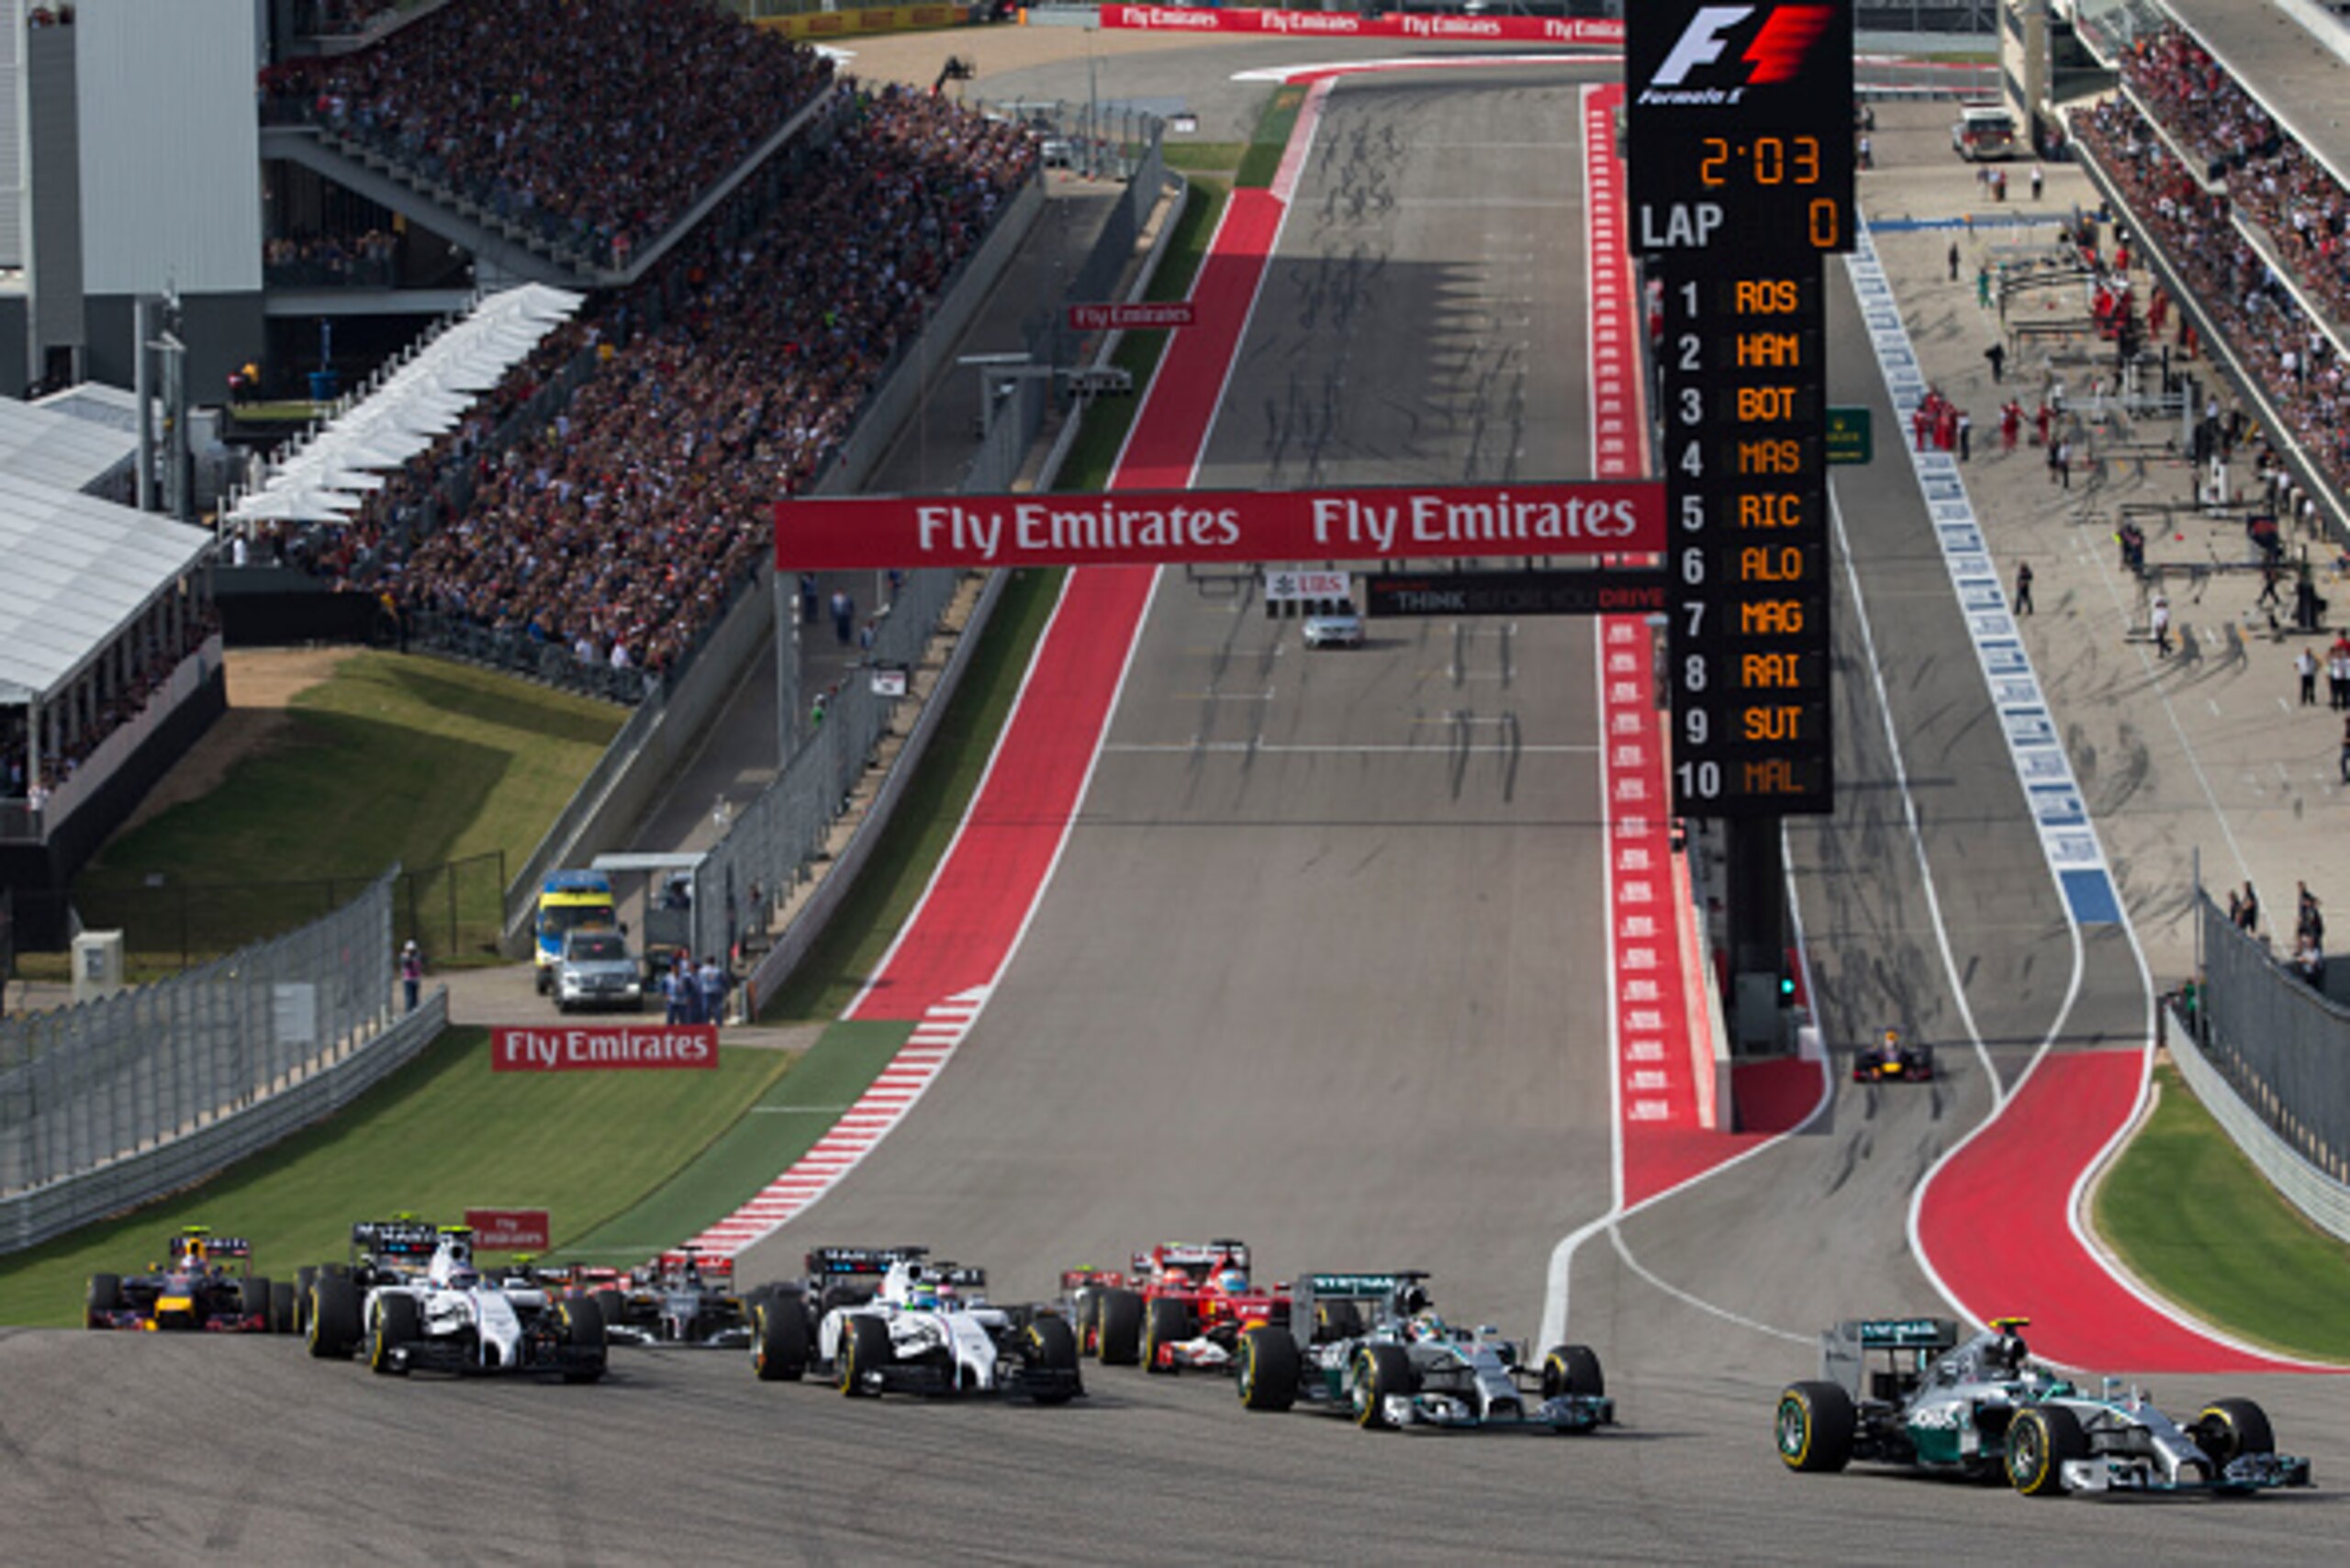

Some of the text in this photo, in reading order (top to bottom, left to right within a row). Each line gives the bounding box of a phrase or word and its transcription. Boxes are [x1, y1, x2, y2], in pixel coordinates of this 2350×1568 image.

[1122, 7, 1217, 28] Fly Emirates
[1260, 10, 1359, 33] Fly Emirates
[1403, 16, 1501, 37] Fly Emirates
[1545, 19, 1573, 40] Fly
[1637, 87, 1725, 105] Formula
[1701, 137, 1819, 185] 2:03
[1641, 198, 1837, 247] LAP 0
[1681, 279, 1798, 317] 1 ROS
[1076, 308, 1192, 326] Fly Emirates
[1679, 332, 1799, 370] 2 HAM
[1681, 386, 1796, 424] 3 BOT
[1681, 440, 1800, 476] 4 MAS
[1313, 492, 1636, 551] Fly Emirates
[1683, 493, 1801, 530] 5 RIC
[917, 502, 1240, 559] Fly Emirates
[1298, 575, 1342, 593] UBS
[1683, 547, 1802, 584] 6 ALO
[1396, 590, 1466, 610] THINK
[1598, 587, 1664, 609] DRIVE
[1684, 599, 1803, 636] 7 MAG
[1685, 653, 1799, 690] 8 RAI
[1687, 706, 1802, 744] 9 SUT
[1677, 761, 1803, 798] 10 MAL
[505, 1027, 709, 1066] Fly Emirates
